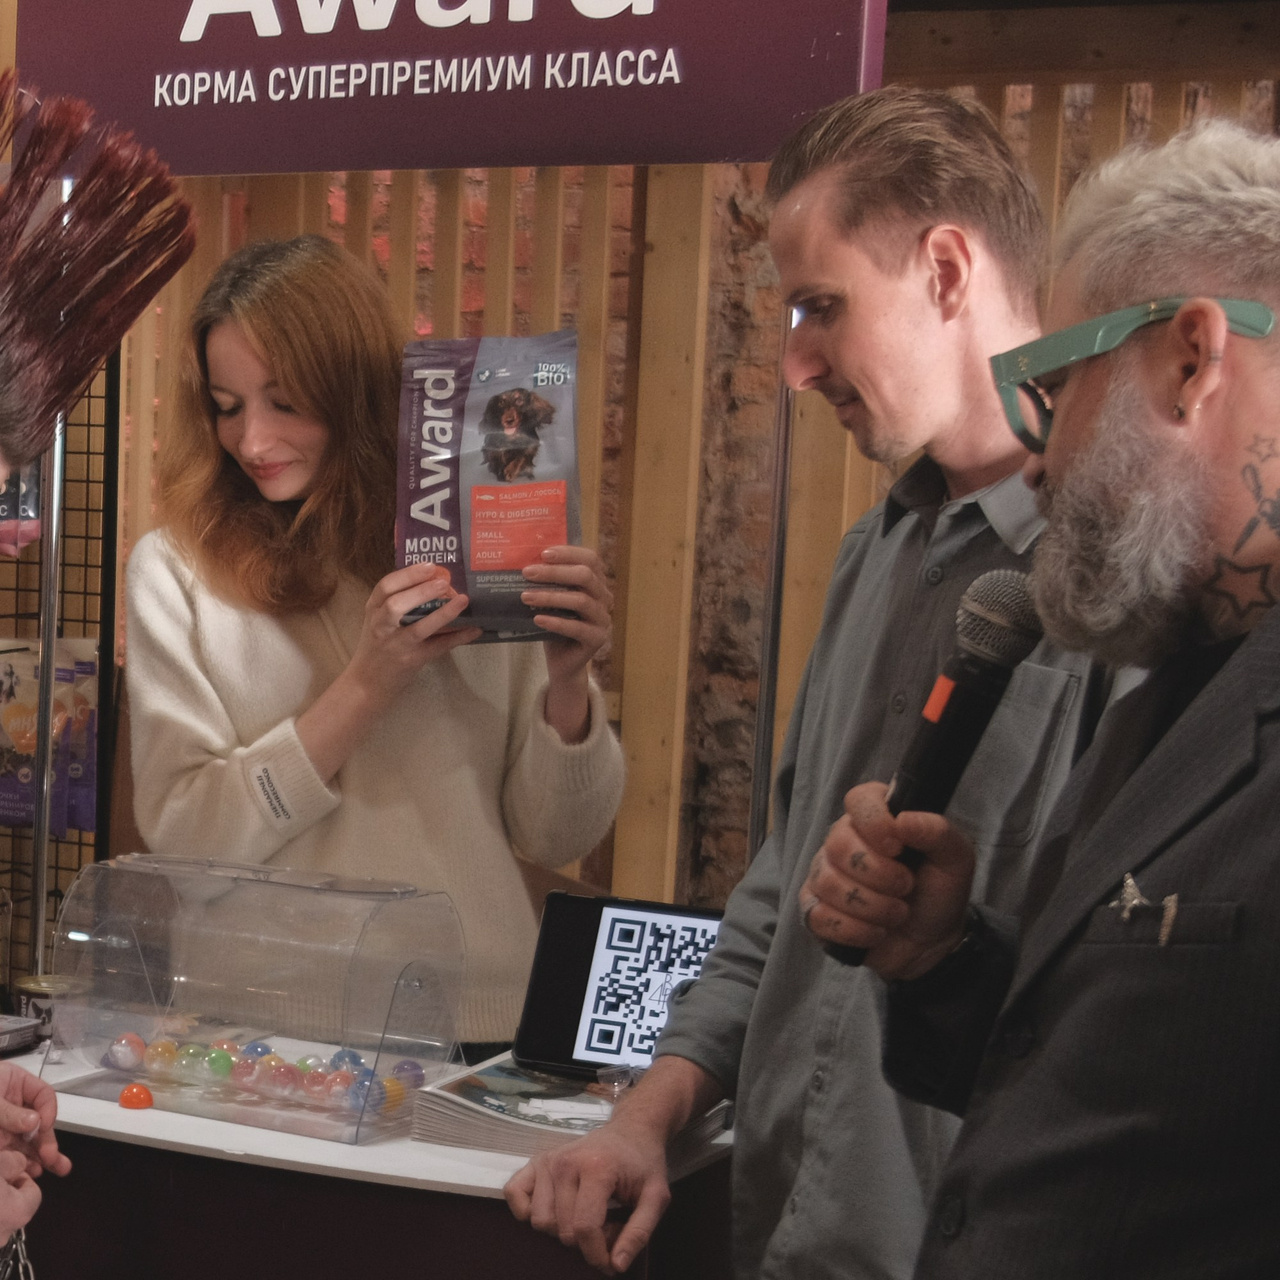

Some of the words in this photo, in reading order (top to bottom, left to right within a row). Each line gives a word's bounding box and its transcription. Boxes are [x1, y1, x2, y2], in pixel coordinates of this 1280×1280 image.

[154, 69, 257, 107] КОРМА
[268, 54, 532, 101] СУПЕРПРЕМИУМ
[544, 47, 681, 89] КЛАССА
[538, 362, 567, 374] 100%
[410, 369, 456, 531] Award
[408, 451, 416, 489] QUALITY
[475, 511, 497, 519] HYPO
[507, 507, 549, 518] DIGESTION
[476, 531, 504, 540] SMALL
[405, 536, 457, 554] MONO
[405, 552, 456, 566] PROTEIN
[476, 551, 502, 559] ADULT
